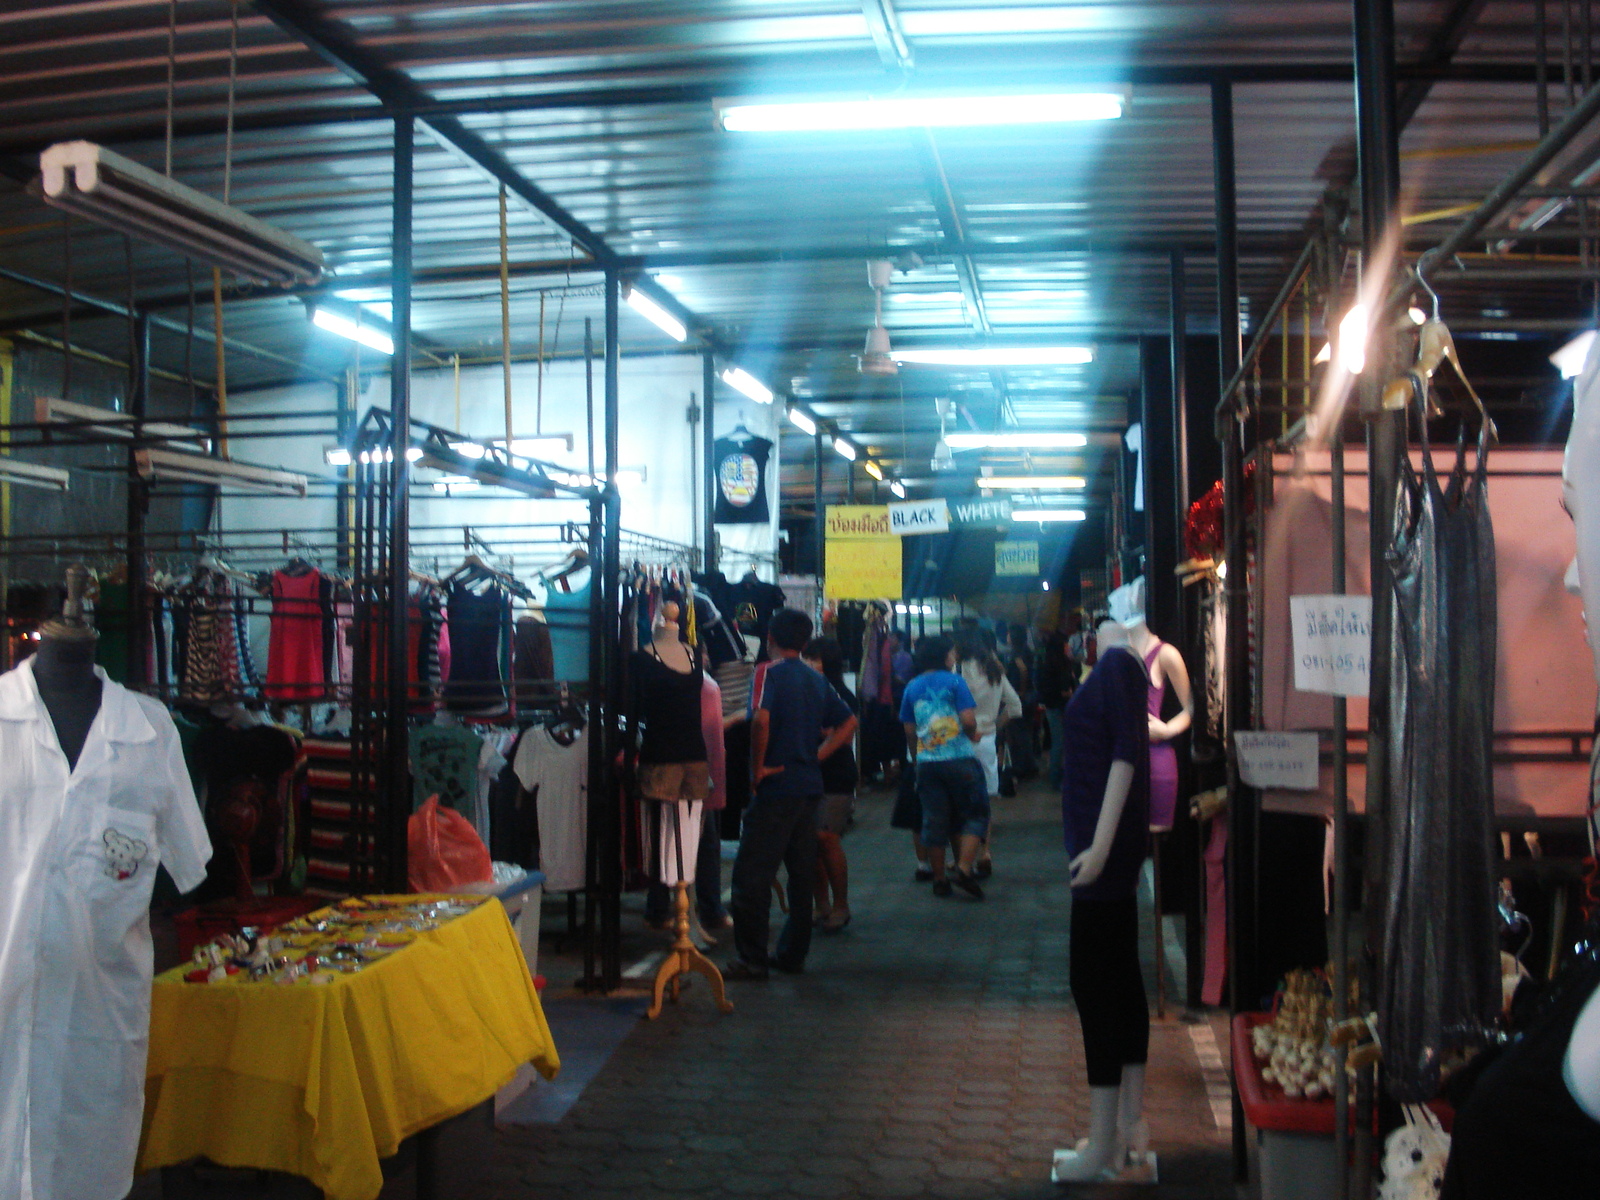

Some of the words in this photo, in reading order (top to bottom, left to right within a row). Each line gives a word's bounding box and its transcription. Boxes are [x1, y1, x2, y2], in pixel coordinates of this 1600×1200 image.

[827, 511, 890, 534] ซ่อมมือถื
[892, 507, 937, 527] BLACK
[956, 499, 1010, 523] WHITE
